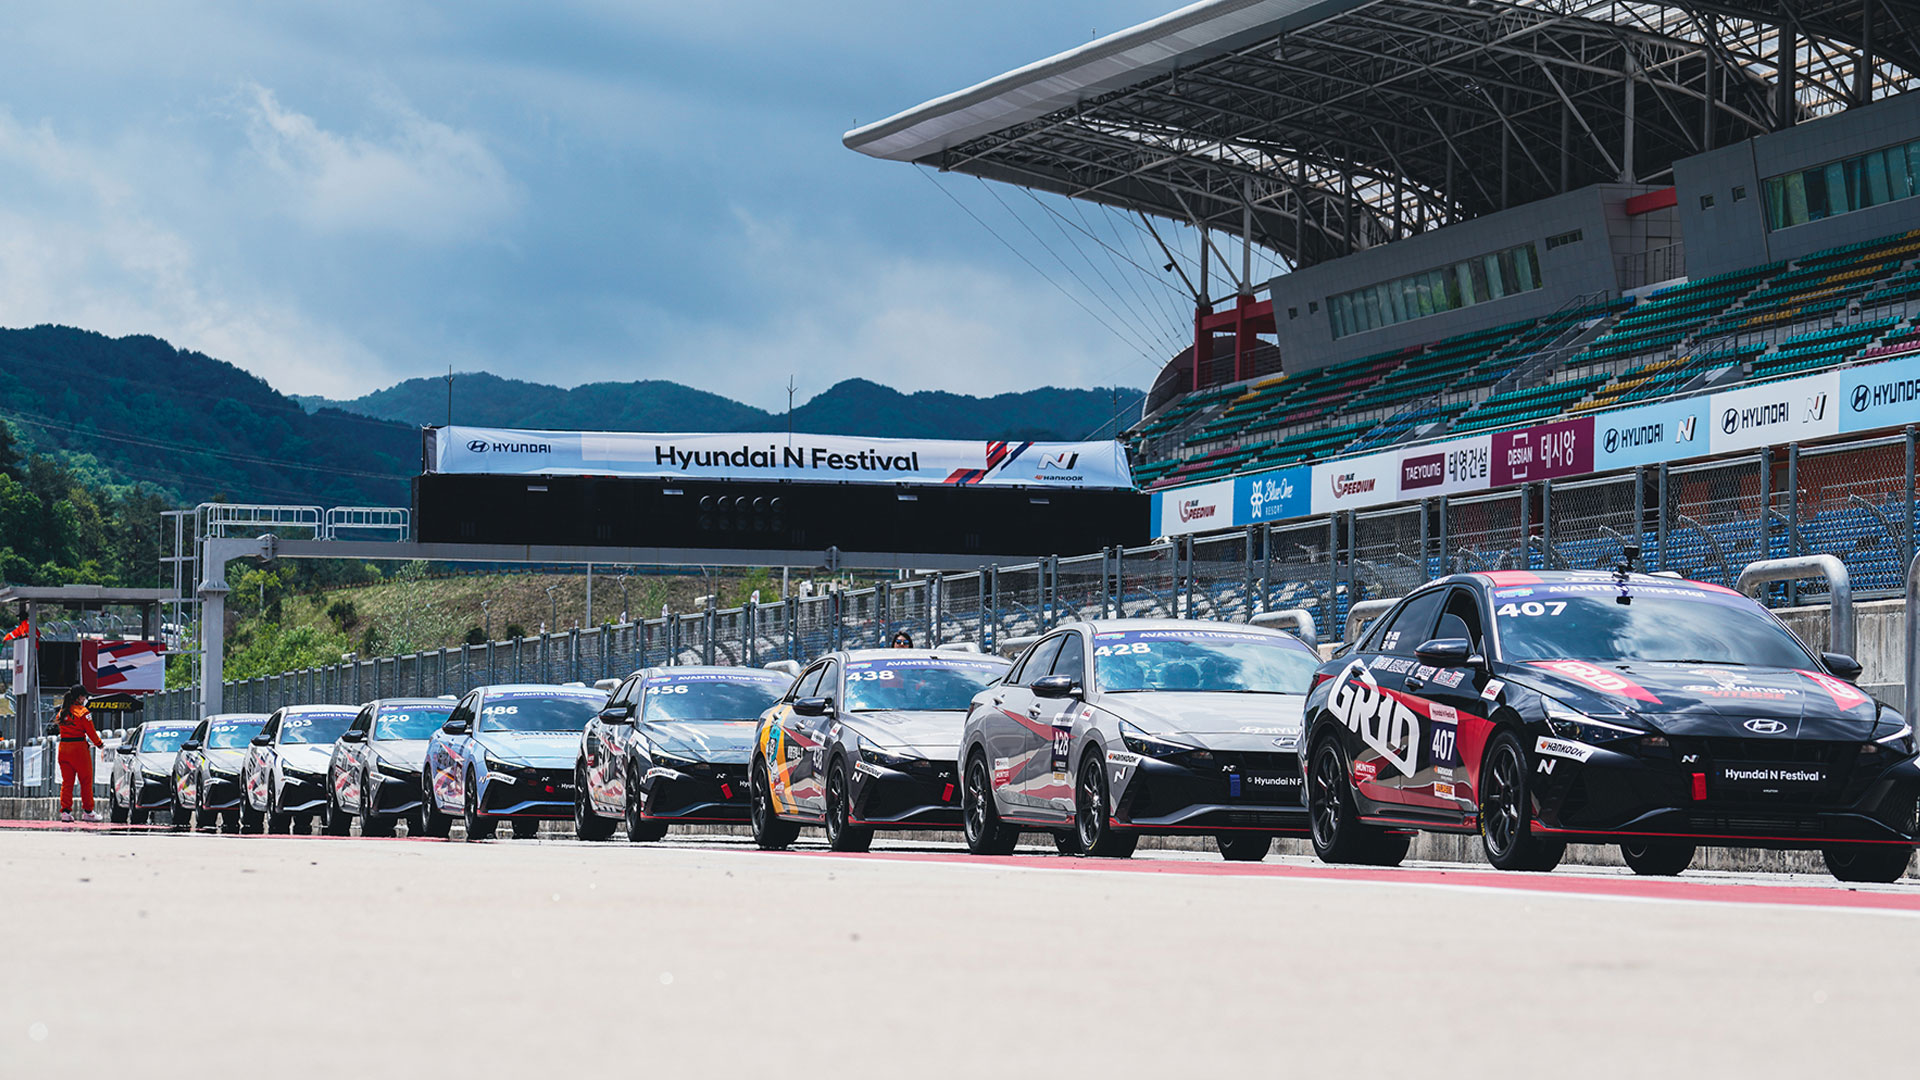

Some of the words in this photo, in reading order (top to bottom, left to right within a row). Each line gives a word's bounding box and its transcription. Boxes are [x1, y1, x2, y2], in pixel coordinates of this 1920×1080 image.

[1741, 401, 1789, 429] HYUNDAI
[1621, 423, 1664, 449] HYUNDAI
[493, 443, 551, 453] HYUNDAI
[1540, 430, 1576, 468] 데시앙
[655, 445, 776, 470] Hyundai
[783, 447, 804, 468] N
[811, 448, 919, 471] Festival
[1448, 445, 1488, 482] 태영건설
[1507, 446, 1533, 466] DESIAN
[1404, 462, 1441, 481] TAEYOUNG
[1549, 585, 1613, 593] AVANTE
[1497, 602, 1567, 617] 407
[1094, 642, 1151, 657] 428
[847, 670, 895, 681] 438
[647, 685, 689, 695] 456
[482, 705, 518, 715] 486
[283, 719, 312, 728] 403
[378, 714, 410, 723] 420
[1054, 731, 1069, 756] 428
[1432, 728, 1455, 760] 407
[1254, 776, 1288, 786] Hyundai
[1725, 768, 1768, 780] Hyundai
[1770, 770, 1778, 779] N
[1780, 770, 1819, 781] Festival
